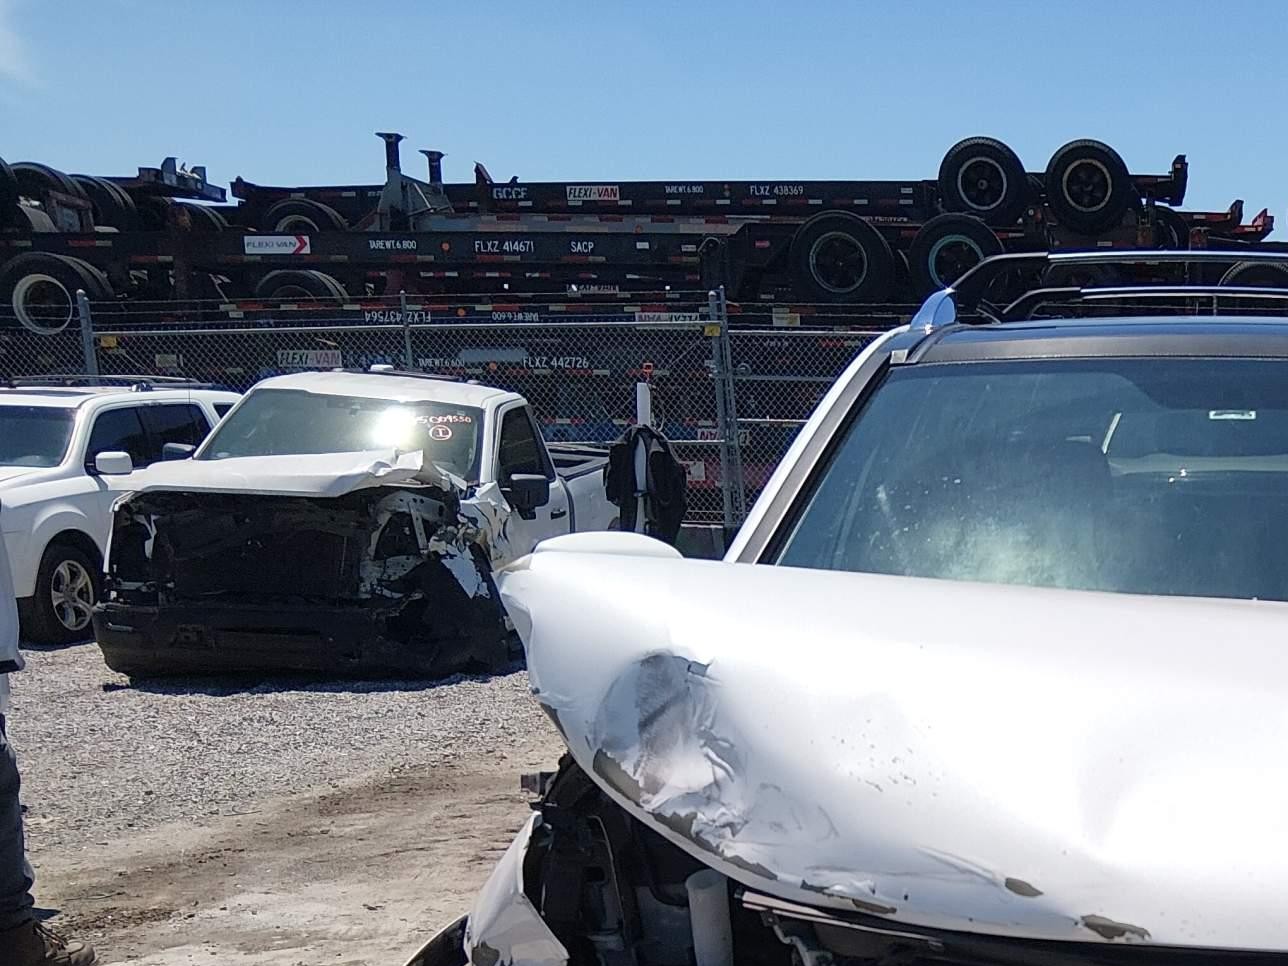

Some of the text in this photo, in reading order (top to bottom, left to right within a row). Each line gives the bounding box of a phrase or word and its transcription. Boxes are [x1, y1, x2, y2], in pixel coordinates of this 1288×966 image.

[568, 187, 618, 199] FLEXI-VAN
[750, 185, 804, 196] FLXZ 438369
[475, 240, 534, 253] FLXZ 414671
[570, 241, 595, 253] SACP
